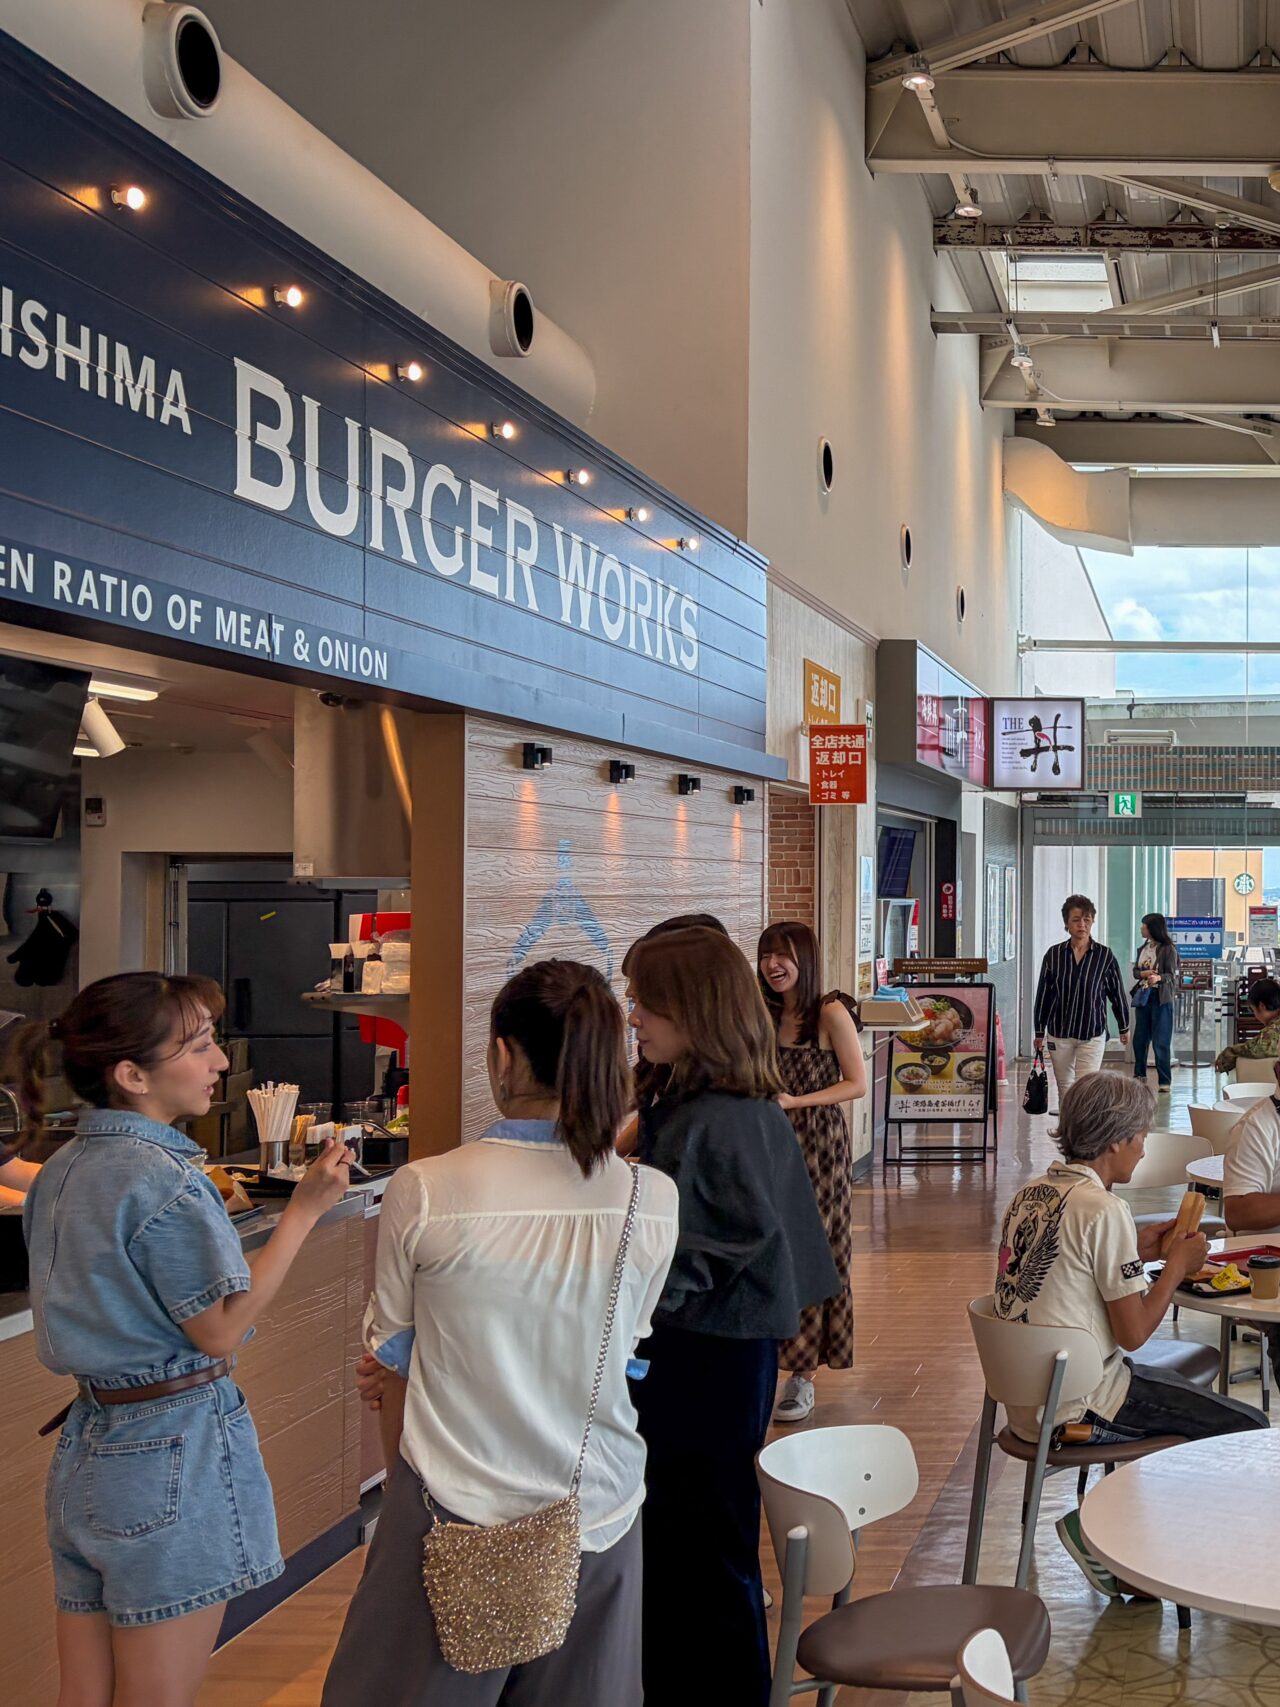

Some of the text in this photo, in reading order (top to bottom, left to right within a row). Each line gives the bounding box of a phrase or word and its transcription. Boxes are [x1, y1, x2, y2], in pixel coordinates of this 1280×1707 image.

[0, 286, 698, 671] ISHIMA BURGER WORKS
[53, 560, 153, 622] RATIO
[167, 593, 206, 634] OF
[215, 606, 284, 655] MEAT
[293, 629, 310, 662] &
[318, 635, 387, 680] ONION
[811, 672, 836, 715] 返却口
[1002, 717, 1024, 730] THE
[811, 734, 865, 749] 全店共通
[815, 751, 862, 765] 返却口
